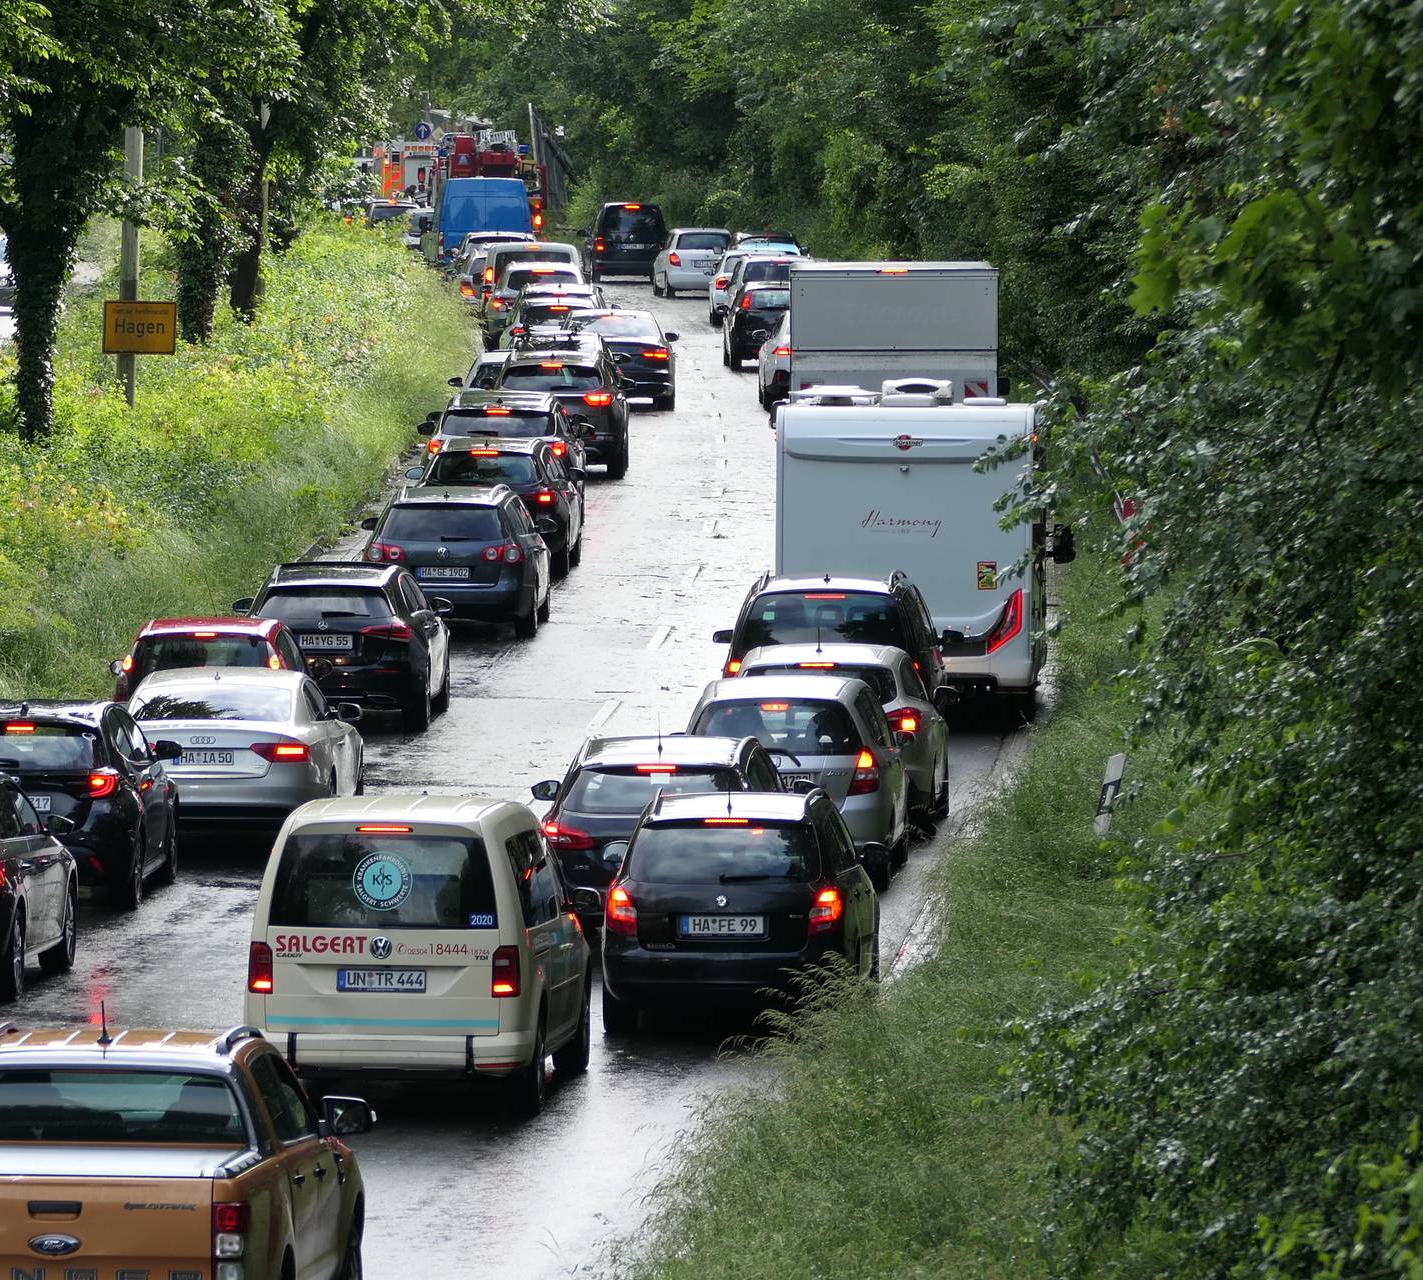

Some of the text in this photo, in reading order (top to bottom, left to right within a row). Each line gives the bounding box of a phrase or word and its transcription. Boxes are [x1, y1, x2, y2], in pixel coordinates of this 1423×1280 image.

[114, 318, 165, 337] Hagen
[862, 510, 942, 538] Harmony
[421, 568, 432, 577] HA
[437, 568, 447, 577] GE
[301, 636, 349, 646] HA YG 55
[180, 752, 233, 764] HA IA 50
[471, 914, 493, 926] 2020
[692, 918, 757, 932] HA FE 99
[275, 935, 367, 954] SALGERT
[347, 972, 424, 986] UN TR 444
